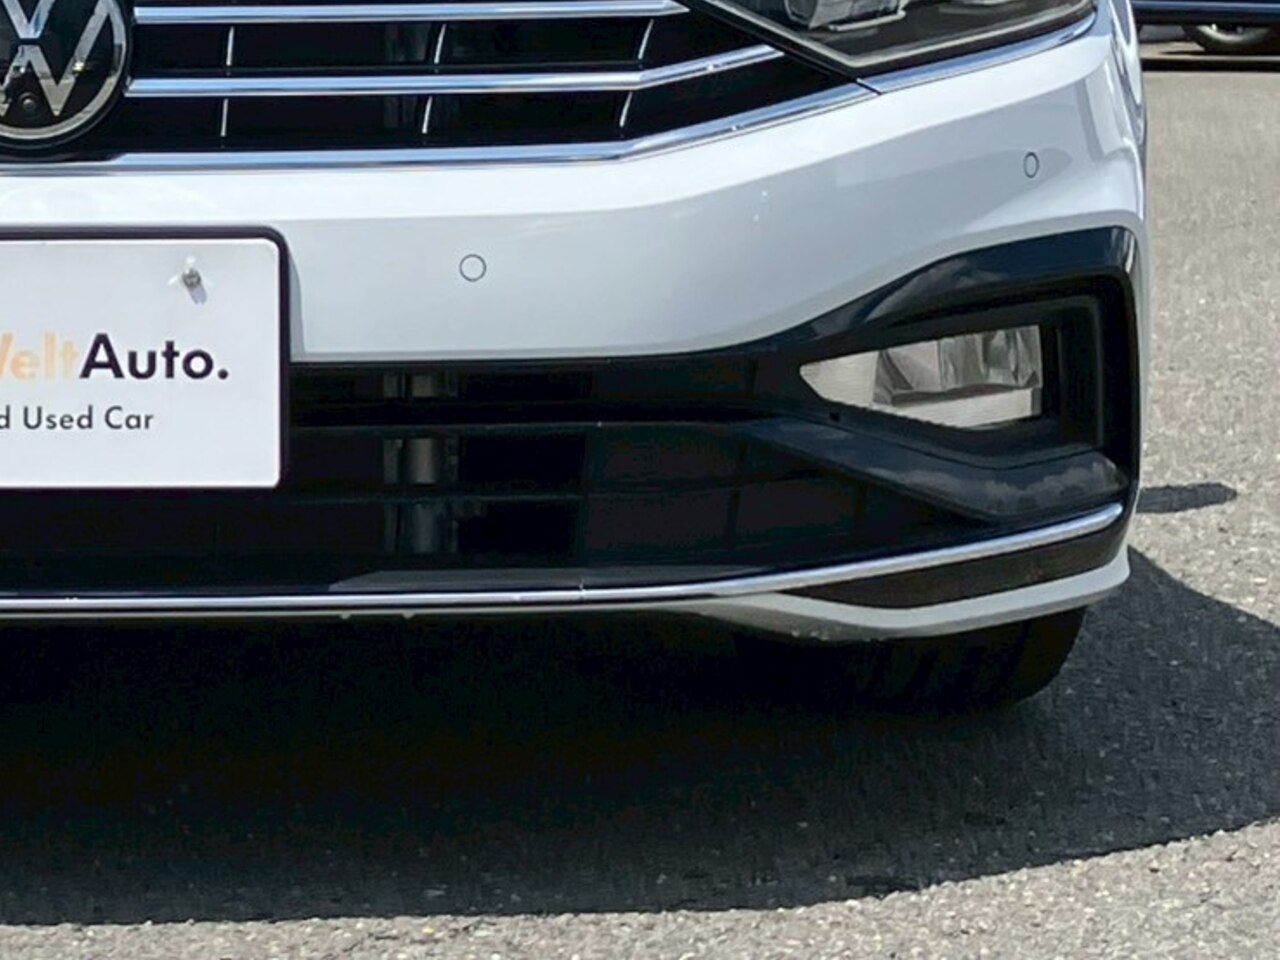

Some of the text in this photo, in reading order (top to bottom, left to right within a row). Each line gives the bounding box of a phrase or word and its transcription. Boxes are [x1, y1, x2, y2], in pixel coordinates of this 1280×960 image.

[80, 333, 229, 380] Auto.
[23, 405, 93, 430] Used
[104, 405, 154, 430] Car
